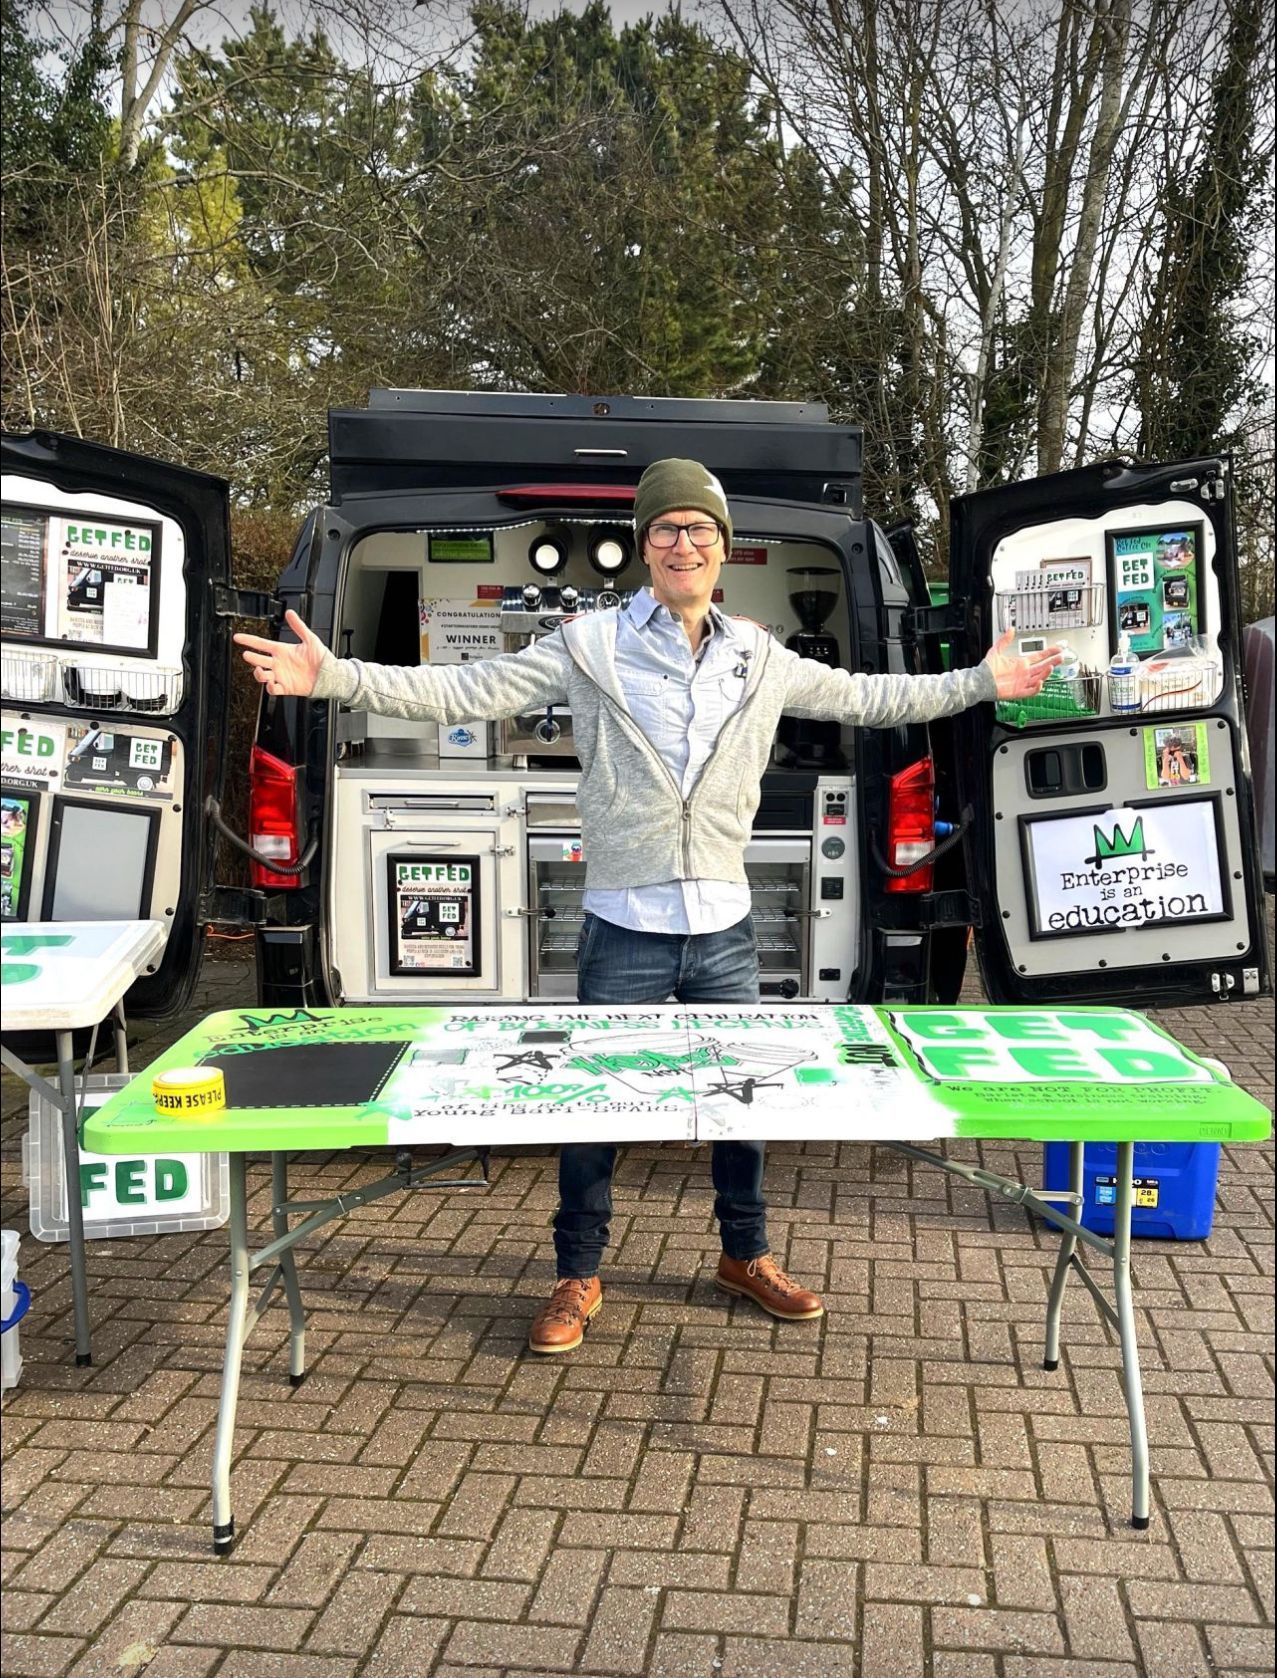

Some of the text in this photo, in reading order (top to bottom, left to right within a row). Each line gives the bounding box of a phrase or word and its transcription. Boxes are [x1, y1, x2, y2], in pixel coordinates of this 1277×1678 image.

[67, 525, 151, 552] GET FED
[1123, 559, 1148, 572] GET
[1066, 571, 1084, 580] FED
[1123, 573, 1149, 586] FED
[446, 635, 497, 645] WINNER
[1, 731, 55, 757] FED
[136, 742, 158, 754] GET
[134, 754, 157, 765] FED
[24, 765, 47, 777] shot
[399, 866, 470, 881] GET FED
[1060, 862, 1189, 890] Enterprise
[1100, 885, 1143, 901] is an
[443, 912, 457, 920] FED
[1049, 893, 1208, 929] education
[202, 1016, 383, 1042] Enterprise
[444, 1019, 824, 1031] OF BUSINESS LEGENDS
[903, 1014, 1141, 1042] GET
[193, 1022, 420, 1060] education
[922, 1047, 1197, 1078] FED
[185, 1088, 222, 1107] PLEASE
[413, 1108, 496, 1118] Young
[79, 1158, 190, 1208] FED
